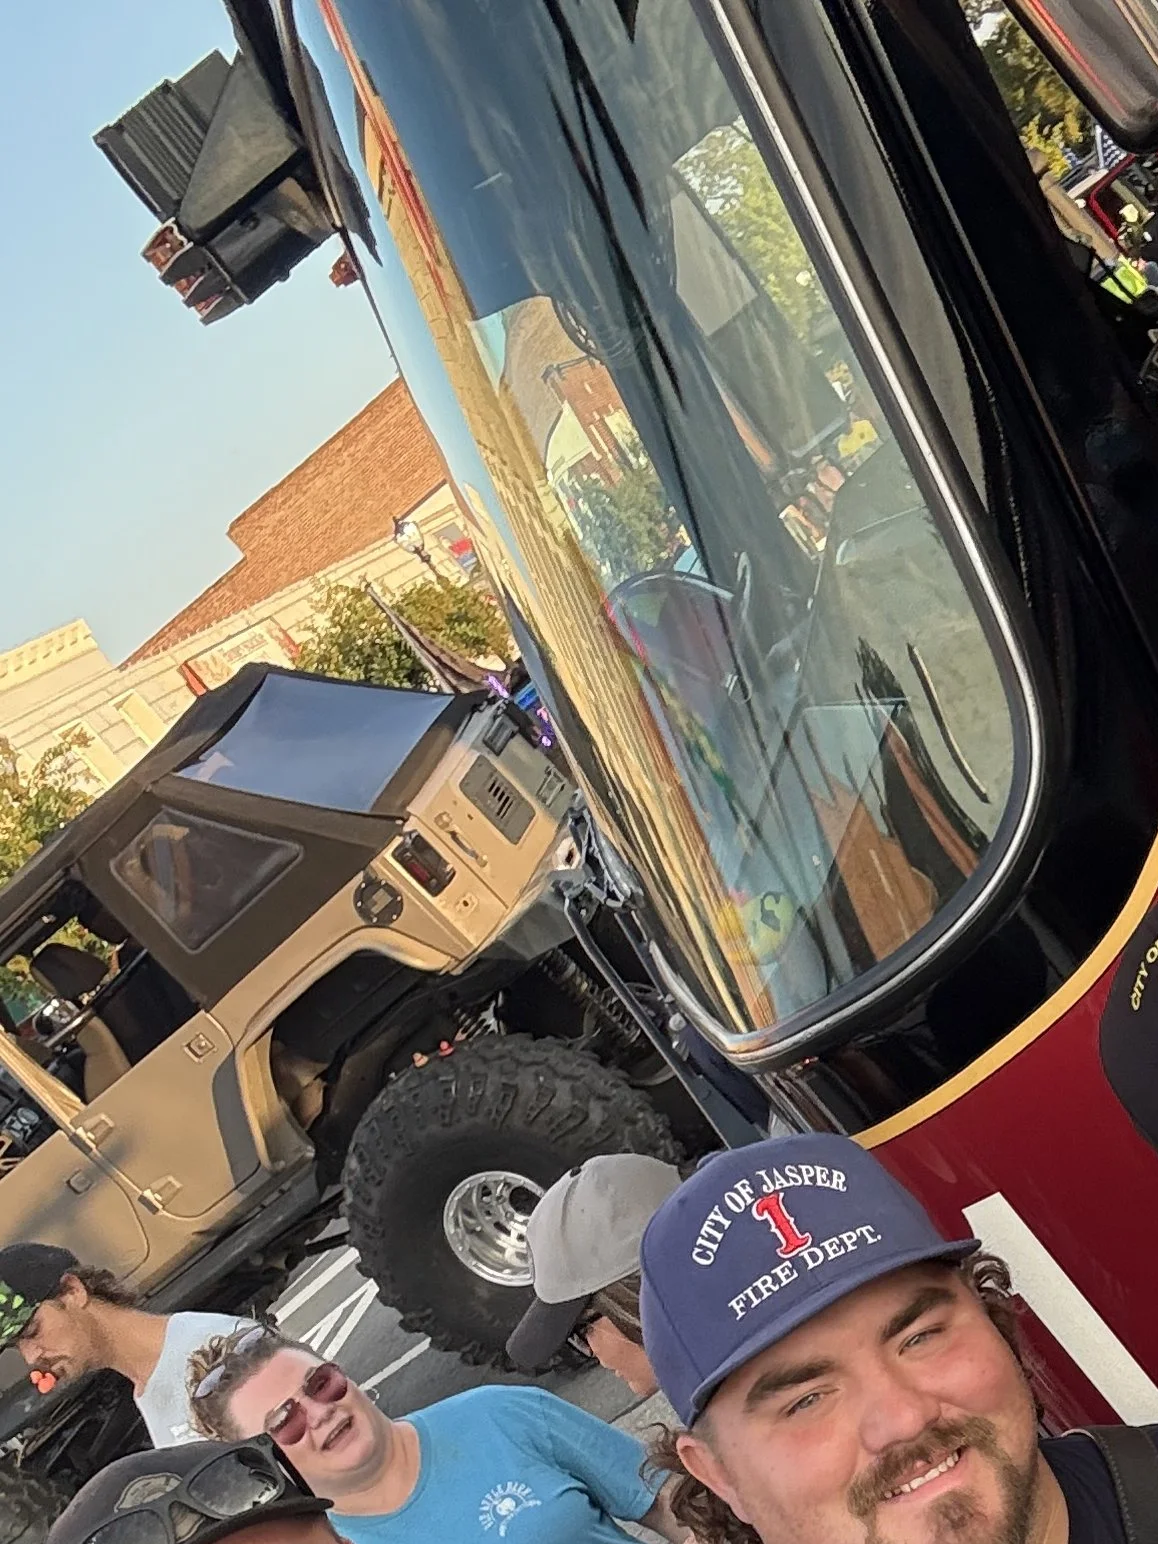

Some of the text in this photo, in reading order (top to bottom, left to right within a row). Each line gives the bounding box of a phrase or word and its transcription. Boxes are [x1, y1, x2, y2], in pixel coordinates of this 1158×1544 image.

[1131, 961, 1149, 1011] CITY
[692, 1164, 848, 1266] CITY OF JASPER
[751, 1191, 813, 1259] 1
[728, 1224, 882, 1321] FIRE DEPT.
